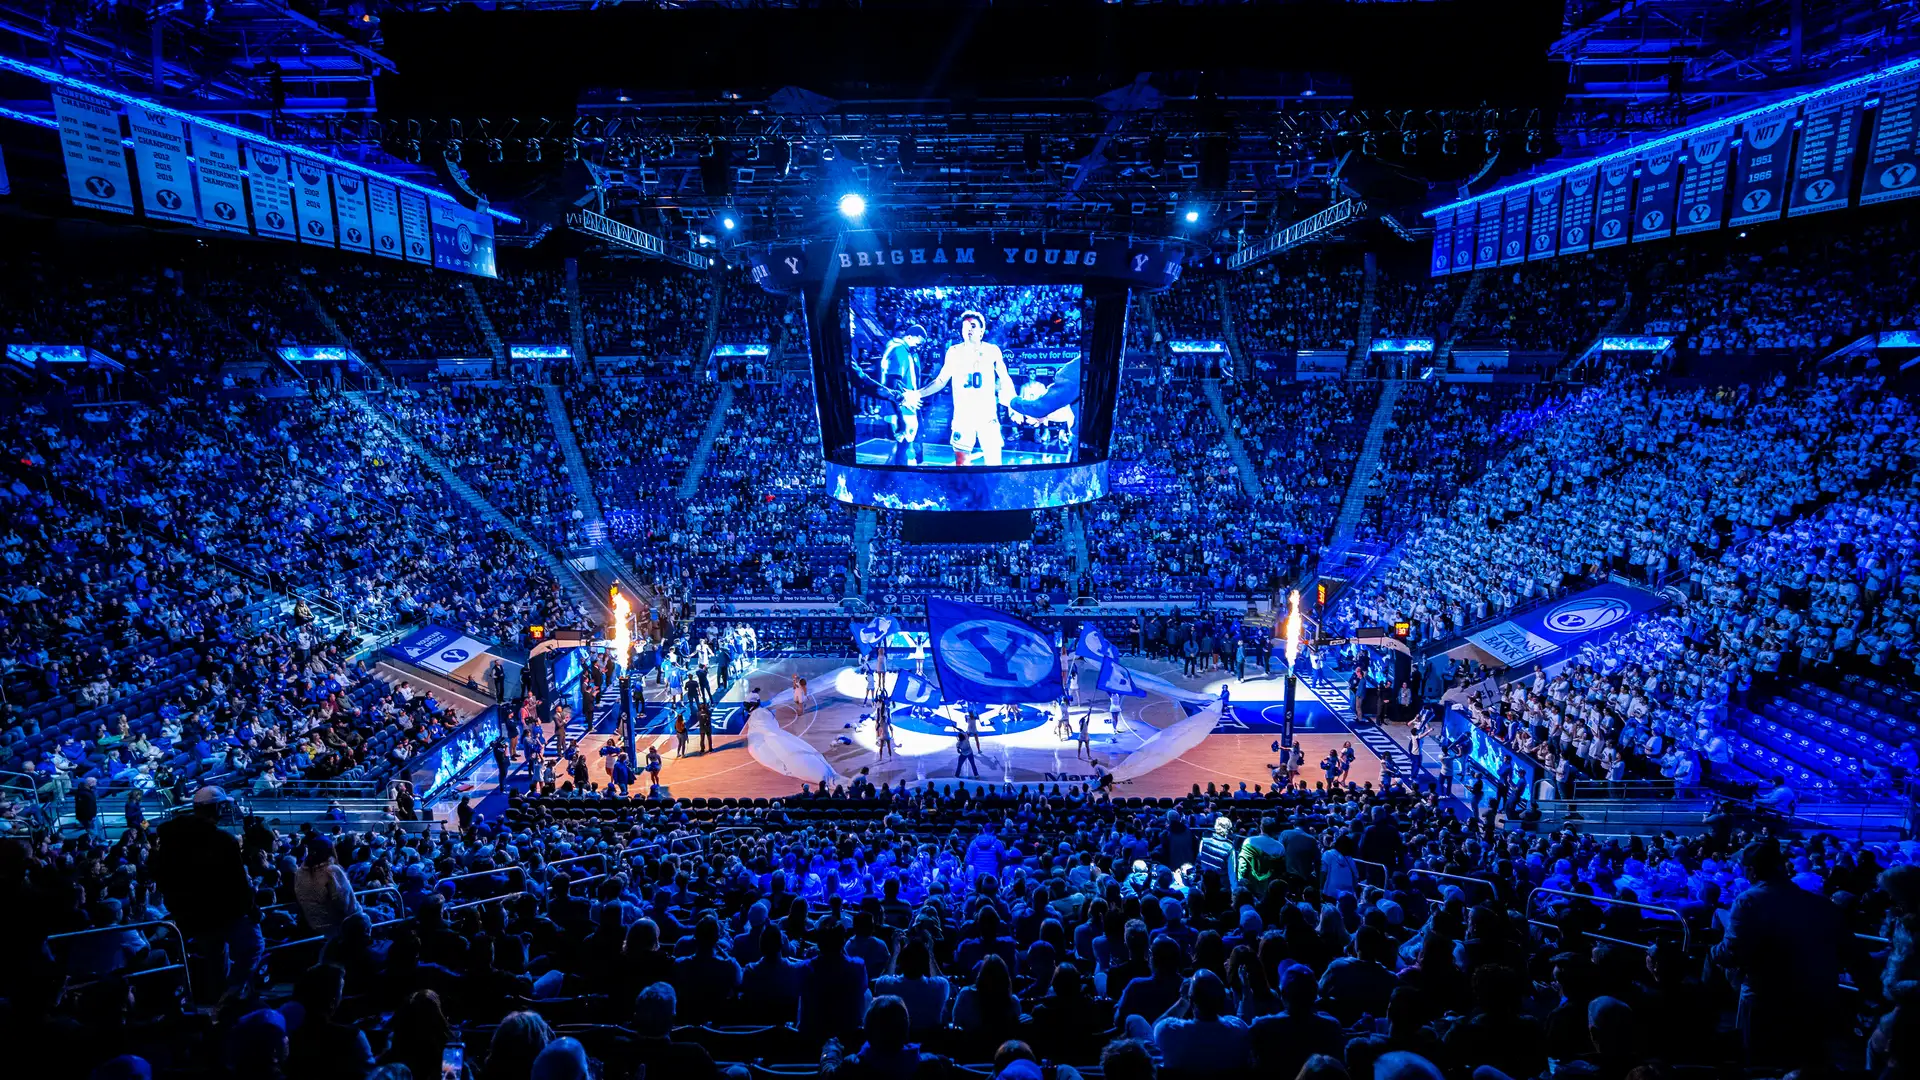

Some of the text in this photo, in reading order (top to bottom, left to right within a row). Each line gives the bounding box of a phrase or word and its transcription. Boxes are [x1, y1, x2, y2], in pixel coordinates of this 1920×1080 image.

[132, 124, 182, 142] TOURNAMENT
[1754, 124, 1780, 142] NIT
[138, 136, 180, 152] CHAMPIONS
[1699, 140, 1720, 158] NIT
[153, 152, 170, 160] 2012
[199, 157, 238, 172] WEST COAST
[1750, 154, 1772, 167] 1951
[155, 162, 172, 172] 2015
[200, 166, 239, 181] CONFERENCE
[1888, 166, 1910, 186] Y
[157, 172, 174, 182] 2019
[203, 176, 239, 190] CHAMPIONS
[1748, 170, 1772, 183] 1966
[1812, 182, 1830, 200] Y
[1748, 191, 1766, 210] Y
[784, 257, 800, 274] Y
[839, 248, 1098, 268] BRIGHAM YOUNG
[1134, 254, 1149, 272] Y
[1049, 351, 1061, 359] for
[1484, 636, 1524, 658] BANK
[1500, 630, 1541, 652] ZIONS
[956, 626, 1030, 682] Y
[905, 676, 936, 703] U
